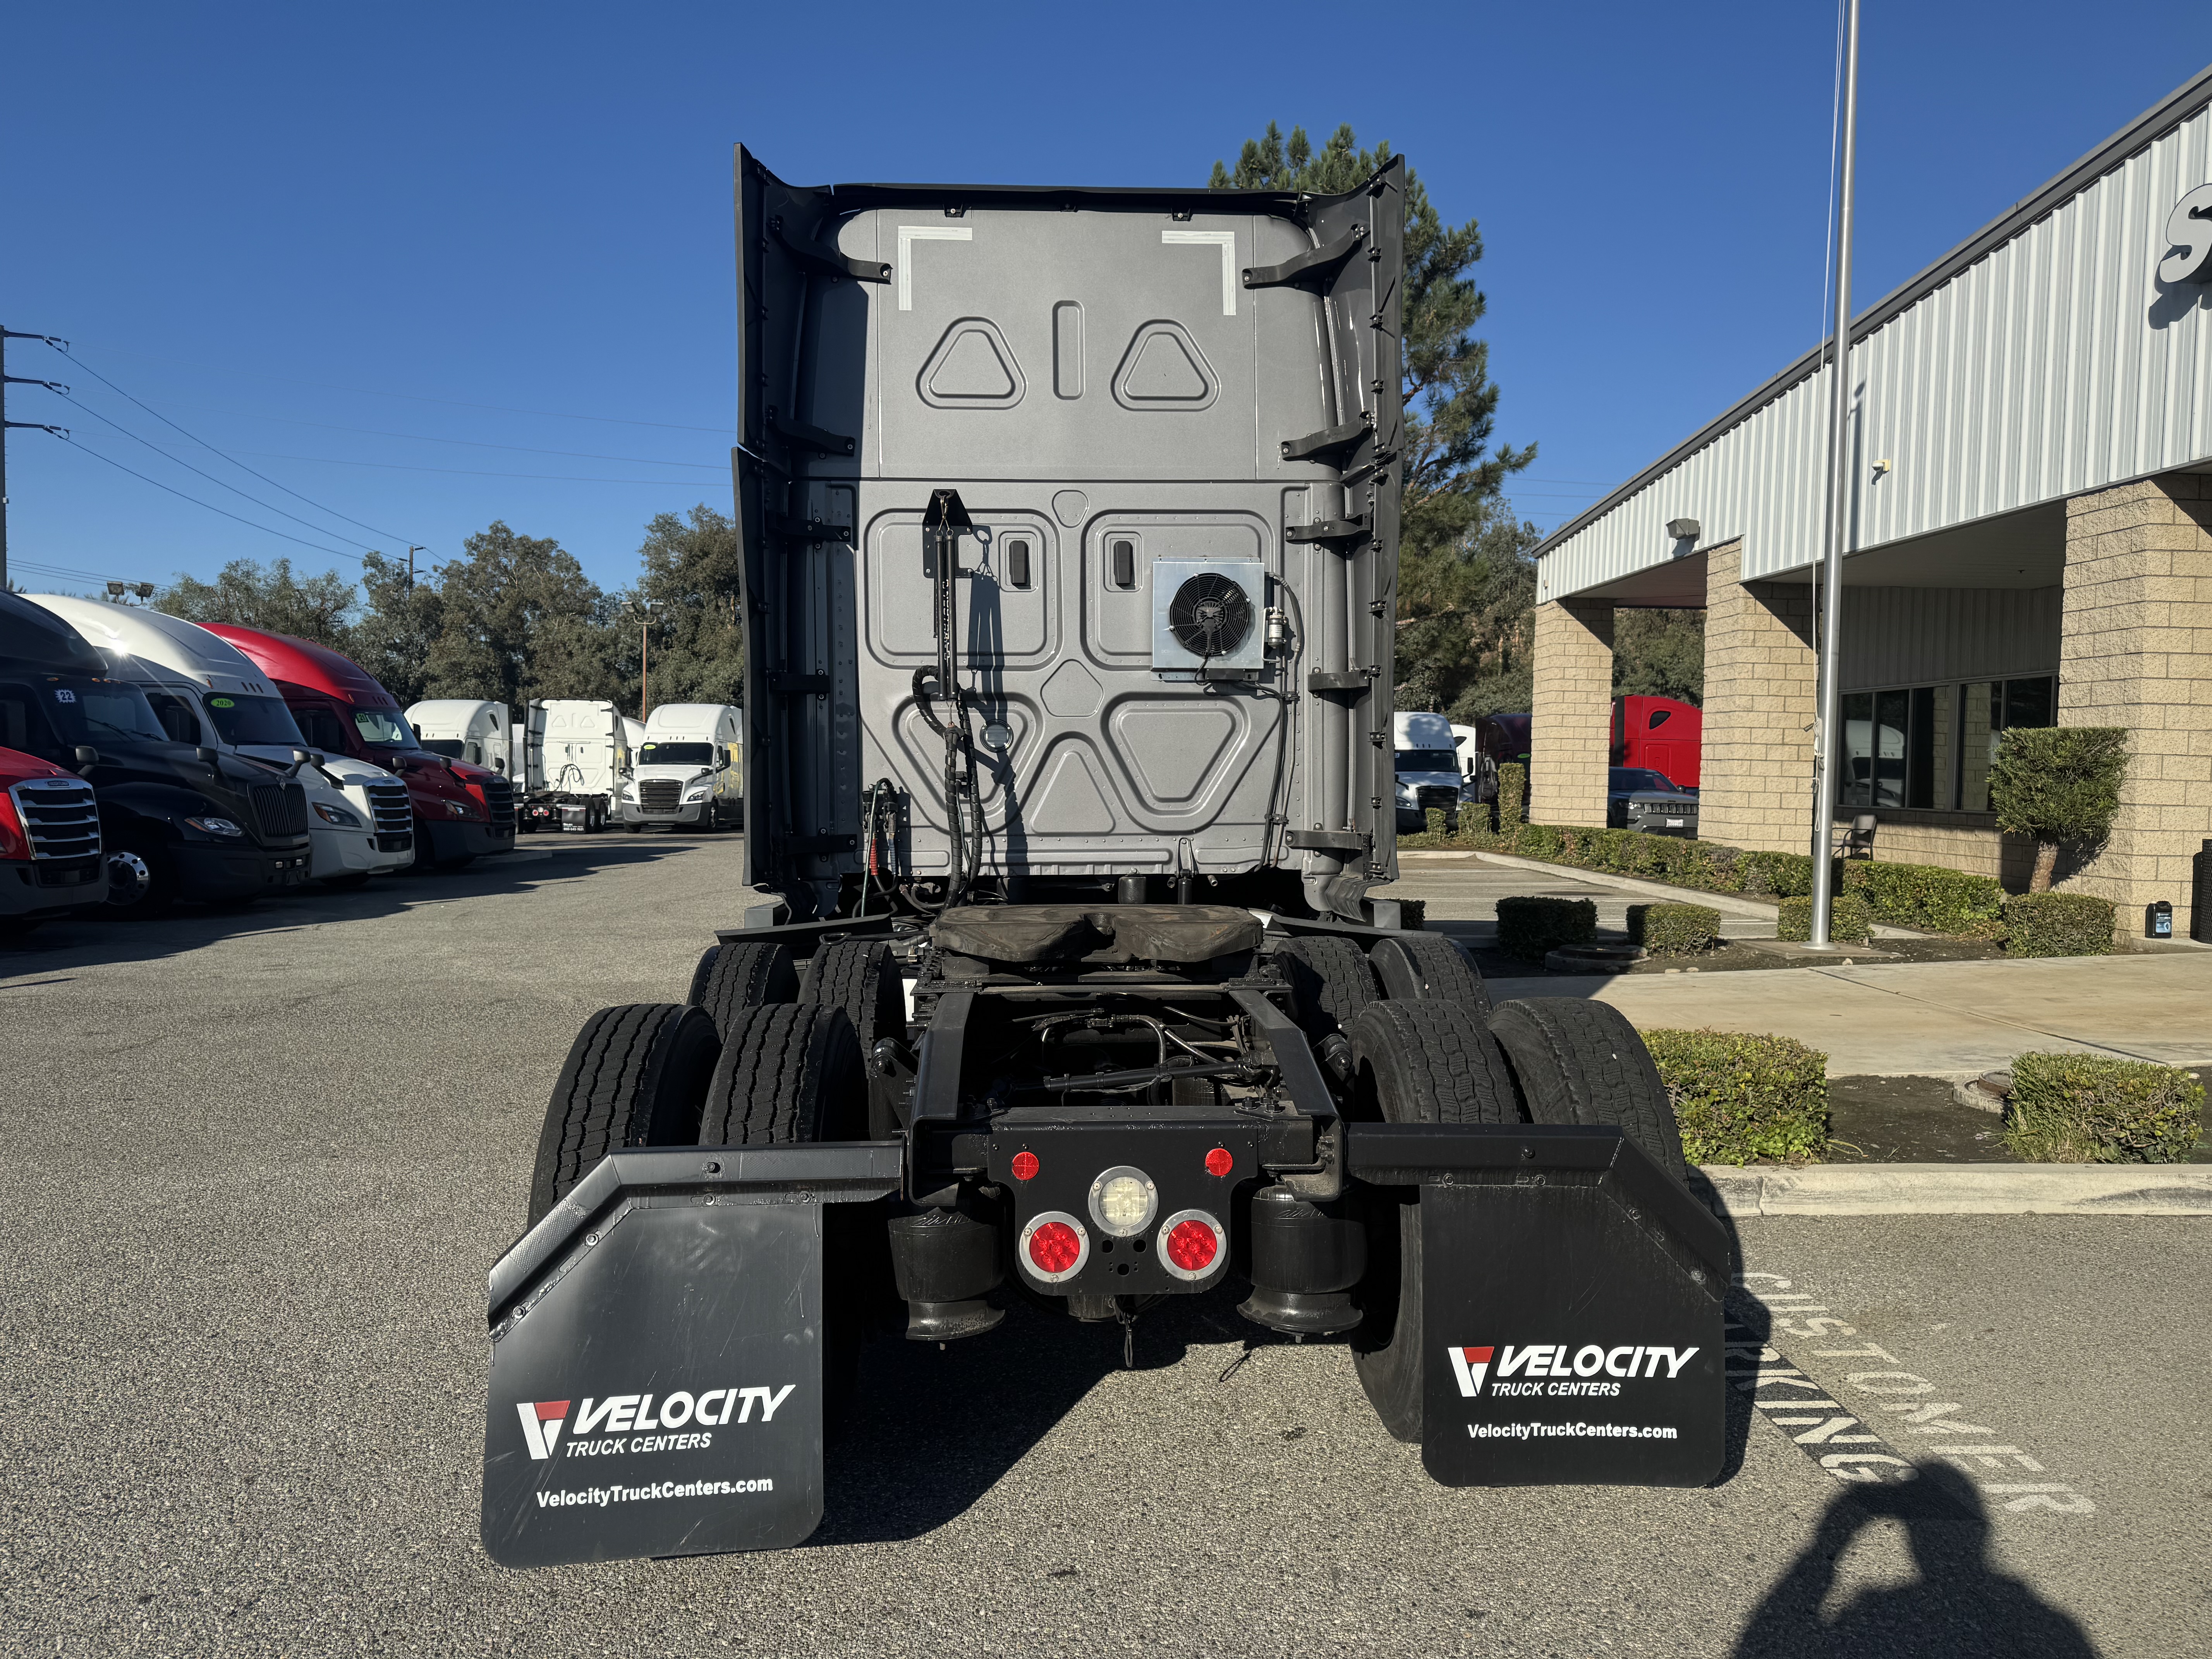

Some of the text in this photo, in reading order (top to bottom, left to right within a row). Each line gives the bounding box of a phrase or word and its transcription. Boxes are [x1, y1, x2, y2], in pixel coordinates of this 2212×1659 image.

[60, 692, 72, 700] 22
[1497, 1345, 1700, 1378] VELOCITY
[1492, 1382, 1621, 1396] TRUCK CENTERS
[1731, 1272, 2097, 1513] CUSTOMER
[573, 1384, 796, 1434] VELOCITY
[566, 1432, 712, 1458] TRUCK CENTERS
[1467, 1422, 1678, 1440] VelocityTruckCenters.com
[536, 1477, 773, 1508] VelocityTruckCenters.com
